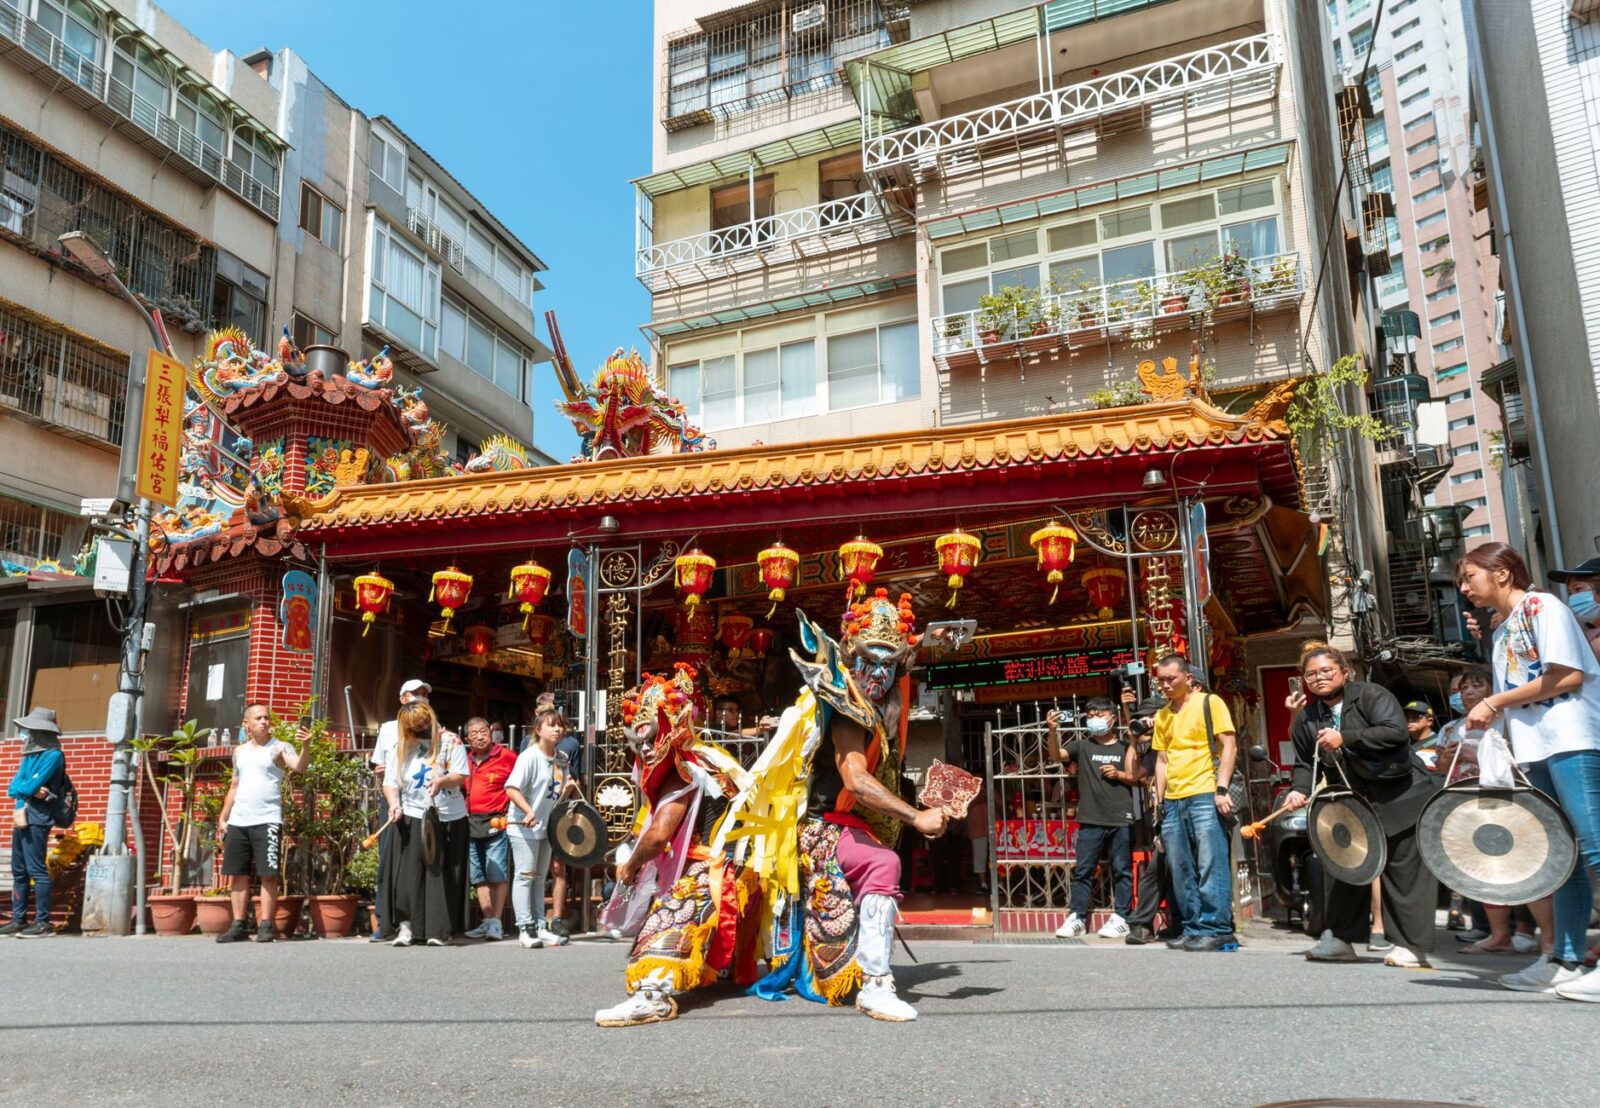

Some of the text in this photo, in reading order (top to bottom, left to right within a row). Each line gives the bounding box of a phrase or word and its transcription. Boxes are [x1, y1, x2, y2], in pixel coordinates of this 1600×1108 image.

[150, 363, 172, 495] 三張犁福佑宮
[605, 556, 630, 583] 德
